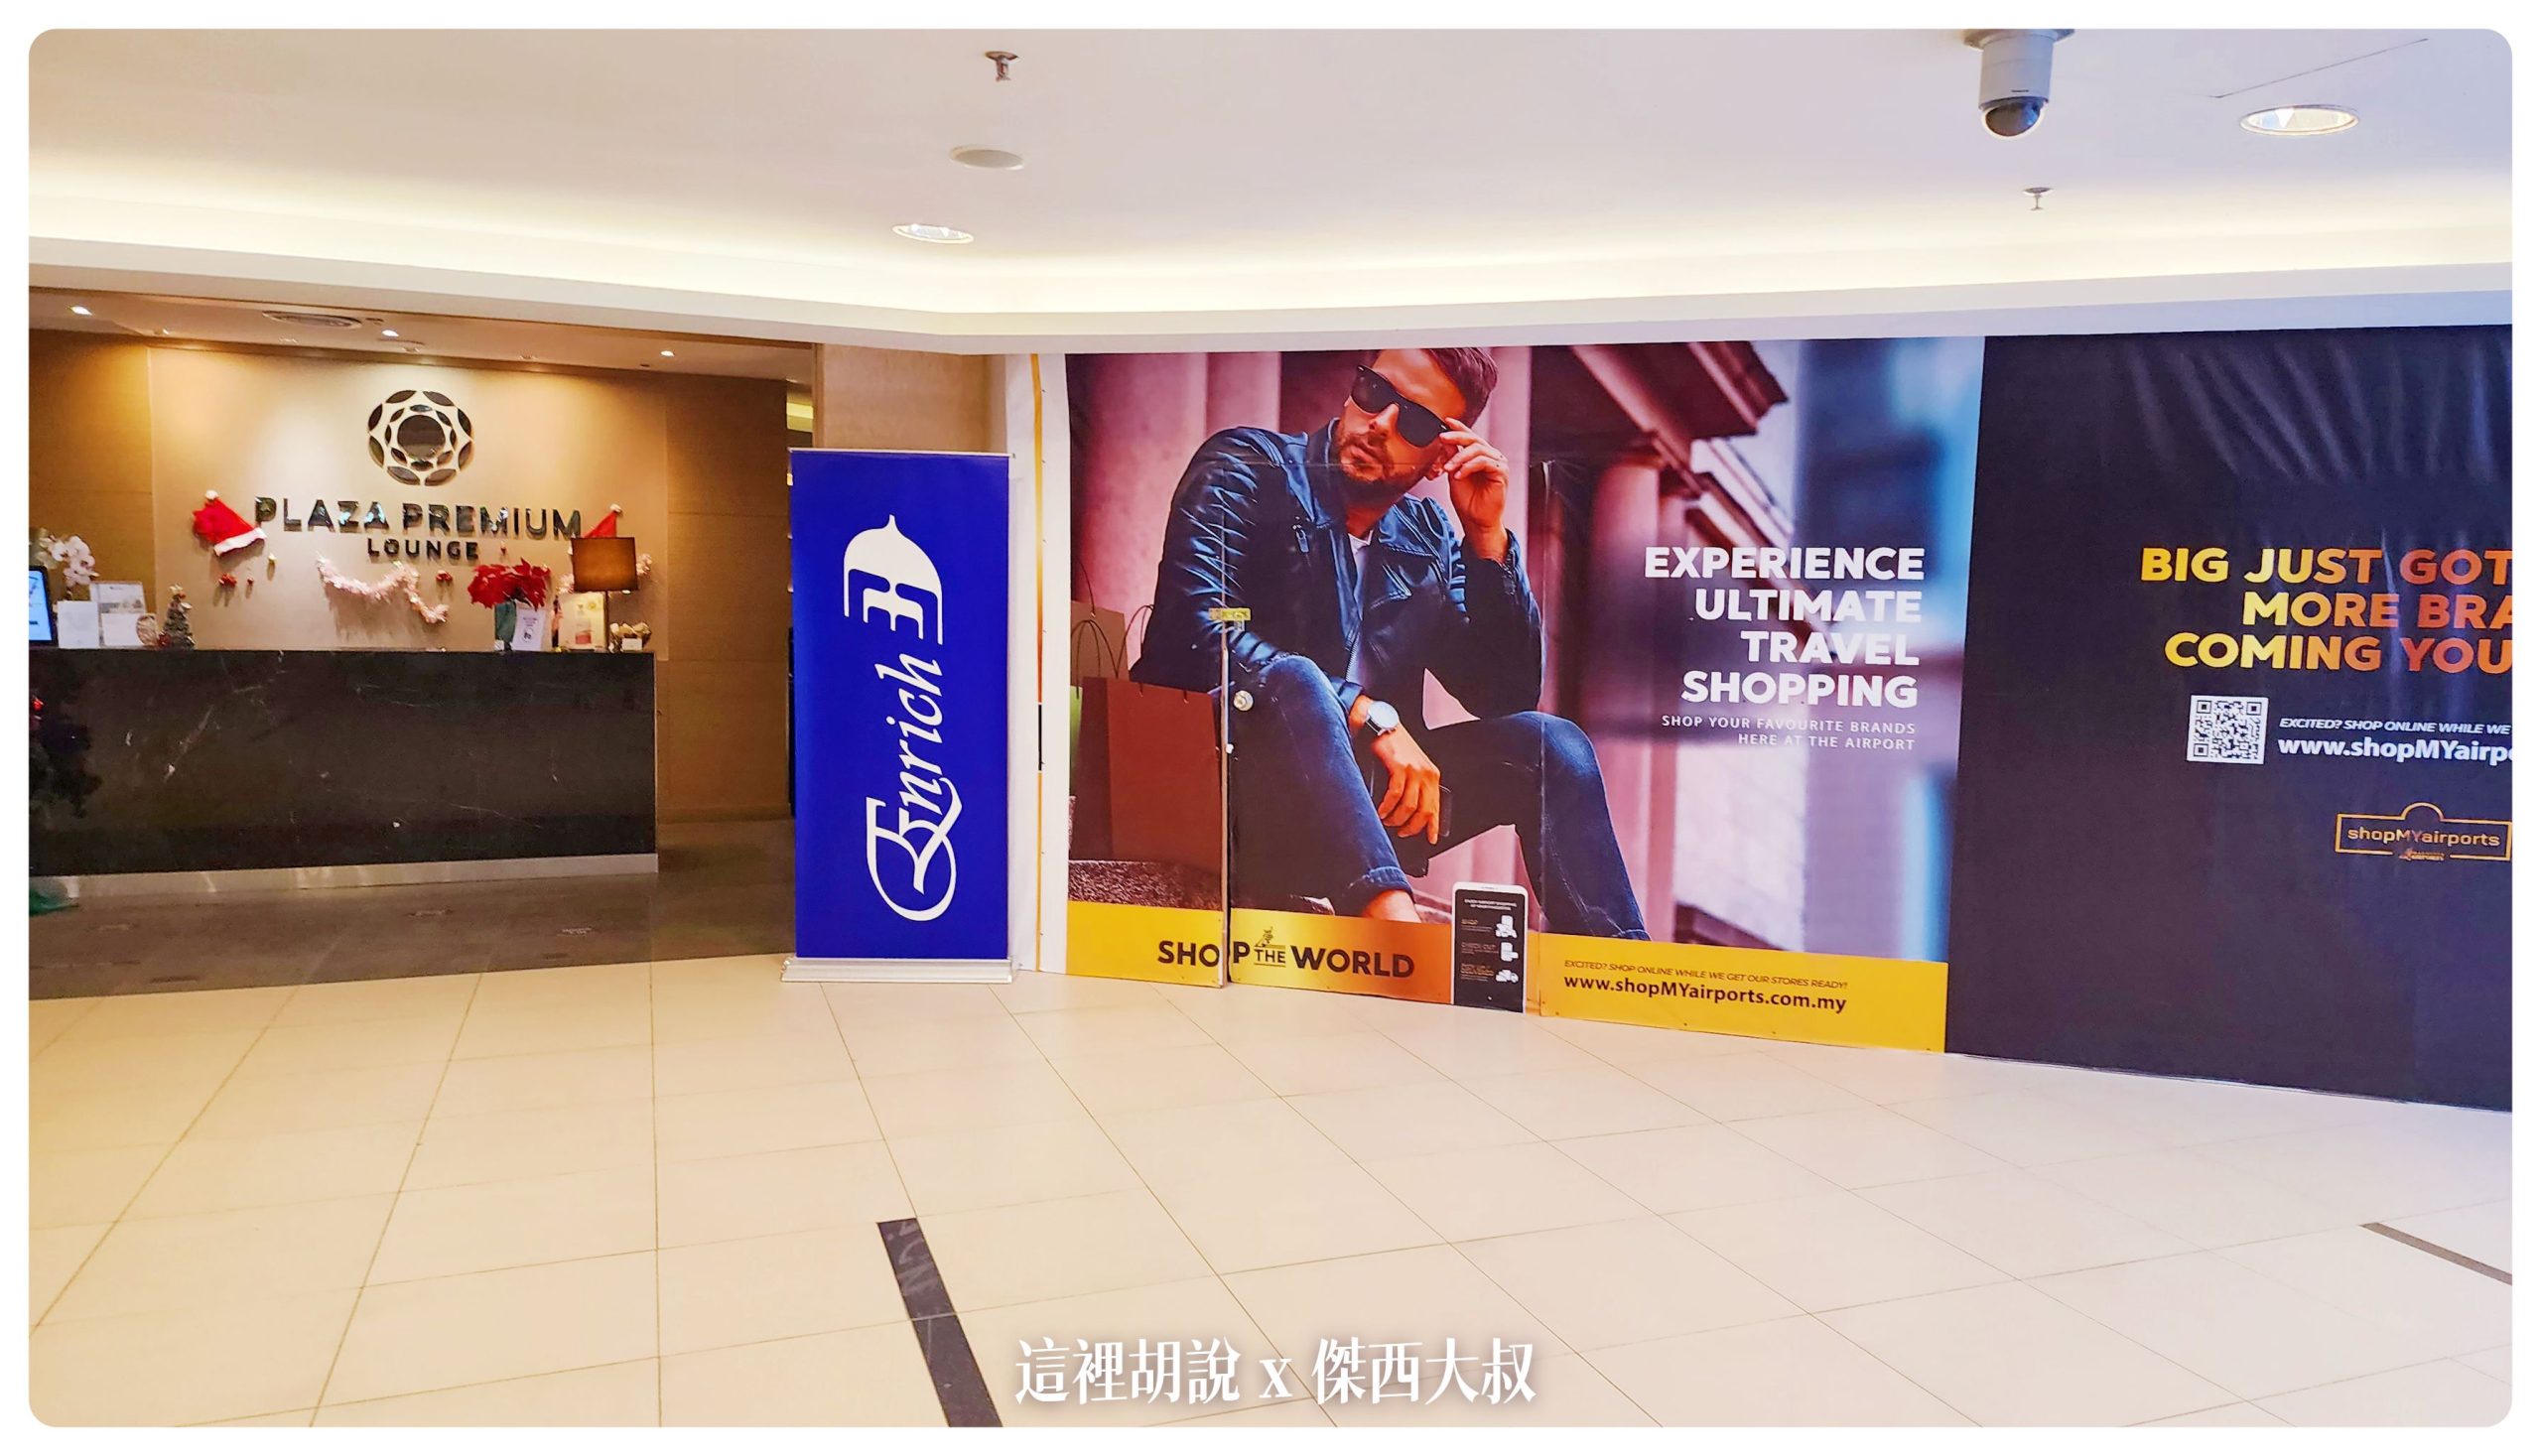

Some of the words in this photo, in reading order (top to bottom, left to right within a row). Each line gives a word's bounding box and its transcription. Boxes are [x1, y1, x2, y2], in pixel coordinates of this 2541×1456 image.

[255, 496, 390, 533] PLAZA
[402, 502, 583, 540] PREMIUM
[367, 538, 479, 560] LOUNGE
[1645, 547, 1925, 580] EXPERIENCE
[2141, 547, 2229, 583] BIG
[2243, 548, 2382, 584] JUST
[2399, 549, 2512, 585] GOT
[1695, 589, 1923, 623] ULTIMATE
[2242, 592, 2399, 627] MORE
[1740, 630, 1920, 665] TRAVEL
[2164, 632, 2382, 671] COMING
[2399, 637, 2512, 674] YOU
[1680, 670, 1919, 709] SHOPPING
[1662, 715, 1702, 727] SHOP
[1709, 717, 1750, 728] YOUR
[1757, 718, 1843, 731] FAVOURITE
[1850, 722, 1915, 734] BRANDS
[2279, 718, 2342, 729] EXCITED?
[2343, 720, 2383, 730] SHOP
[2384, 721, 2438, 732] ONLINE
[2438, 723, 2484, 734] WHILE
[2486, 724, 2511, 734] WE
[1738, 733, 1777, 745] HERE
[1785, 735, 1801, 745] AT
[1808, 736, 1838, 747] THE
[1845, 737, 1915, 750] AIRPORT
[2278, 736, 2512, 766] www.shopMYairp
[867, 650, 962, 921] Enrich
[2347, 827, 2500, 847] shopMYairports
[1254, 949, 1285, 964] THE
[1290, 945, 1414, 978] WORLD
[1564, 960, 1607, 970] EXCITED?
[1609, 963, 1636, 972] SHOP
[1637, 966, 1673, 976] ONLINE
[1674, 969, 1706, 979] WHILE
[1727, 973, 1746, 982] GET
[1771, 977, 1808, 987] STORES
[1564, 977, 1846, 1014] www.shopMYairports.com.my
